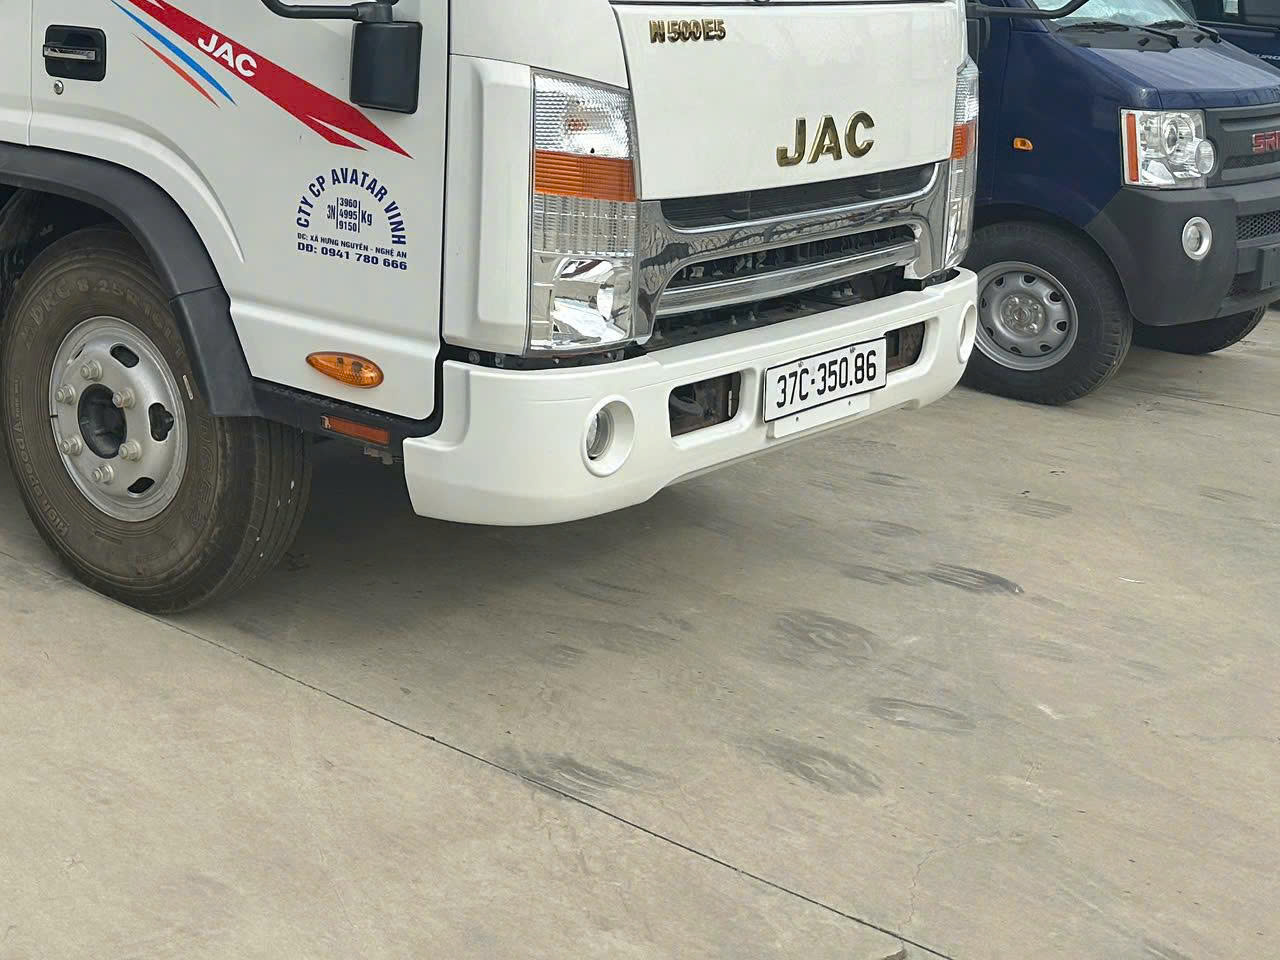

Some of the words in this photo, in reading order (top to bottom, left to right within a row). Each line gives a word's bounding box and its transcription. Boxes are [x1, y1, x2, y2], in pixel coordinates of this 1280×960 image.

[198, 34, 257, 77] JAC
[775, 110, 876, 167] JAC
[296, 195, 314, 228] CTY
[308, 175, 326, 198] CP
[330, 167, 388, 202] AVATAR
[383, 200, 407, 245] VINH
[340, 197, 358, 209] 3960
[339, 209, 358, 221] 4995
[361, 209, 373, 226] Kg
[339, 220, 357, 233] 9150
[321, 246, 350, 260] 0941
[355, 252, 379, 265] 780
[382, 258, 408, 271] 666
[396, 250, 407, 259] AN
[775, 348, 878, 409] 37C-350.86
